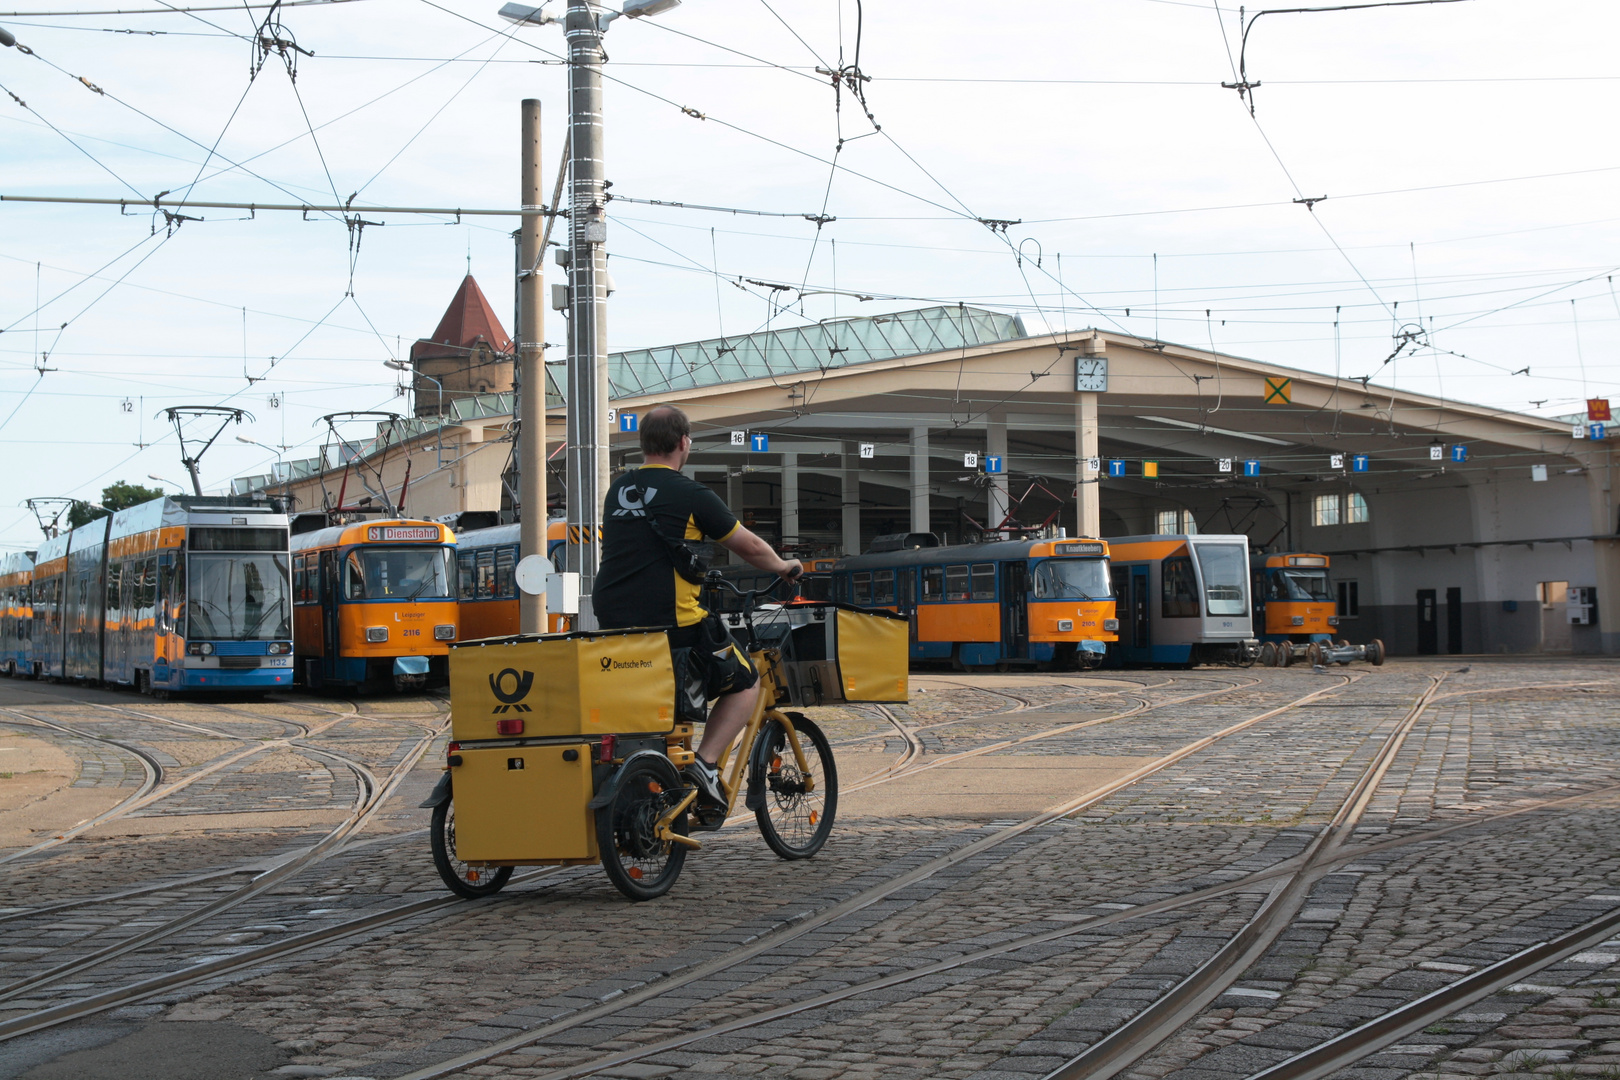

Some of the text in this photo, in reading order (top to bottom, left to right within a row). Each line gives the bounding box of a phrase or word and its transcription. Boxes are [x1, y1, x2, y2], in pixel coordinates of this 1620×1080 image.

[121, 402, 133, 412] 12
[269, 398, 279, 408] 13
[1589, 400, 1607, 411] W
[623, 415, 634, 430] T
[1592, 425, 1601, 438] T
[733, 433, 743, 443] 16
[754, 436, 765, 450] T
[863, 447, 872, 456] 17
[1431, 449, 1441, 459] 22
[1455, 447, 1464, 460] T
[966, 456, 975, 466] 18
[989, 457, 998, 471] T
[1090, 459, 1098, 469] 19
[1220, 460, 1230, 470] 20
[1356, 457, 1365, 470] T
[1113, 462, 1122, 475] T
[1248, 462, 1257, 475] T
[371, 527, 437, 539] S Dienstfahrt
[402, 629, 421, 637] 2116
[269, 658, 287, 666] 1132
[613, 659, 653, 669] Deutsche Post
